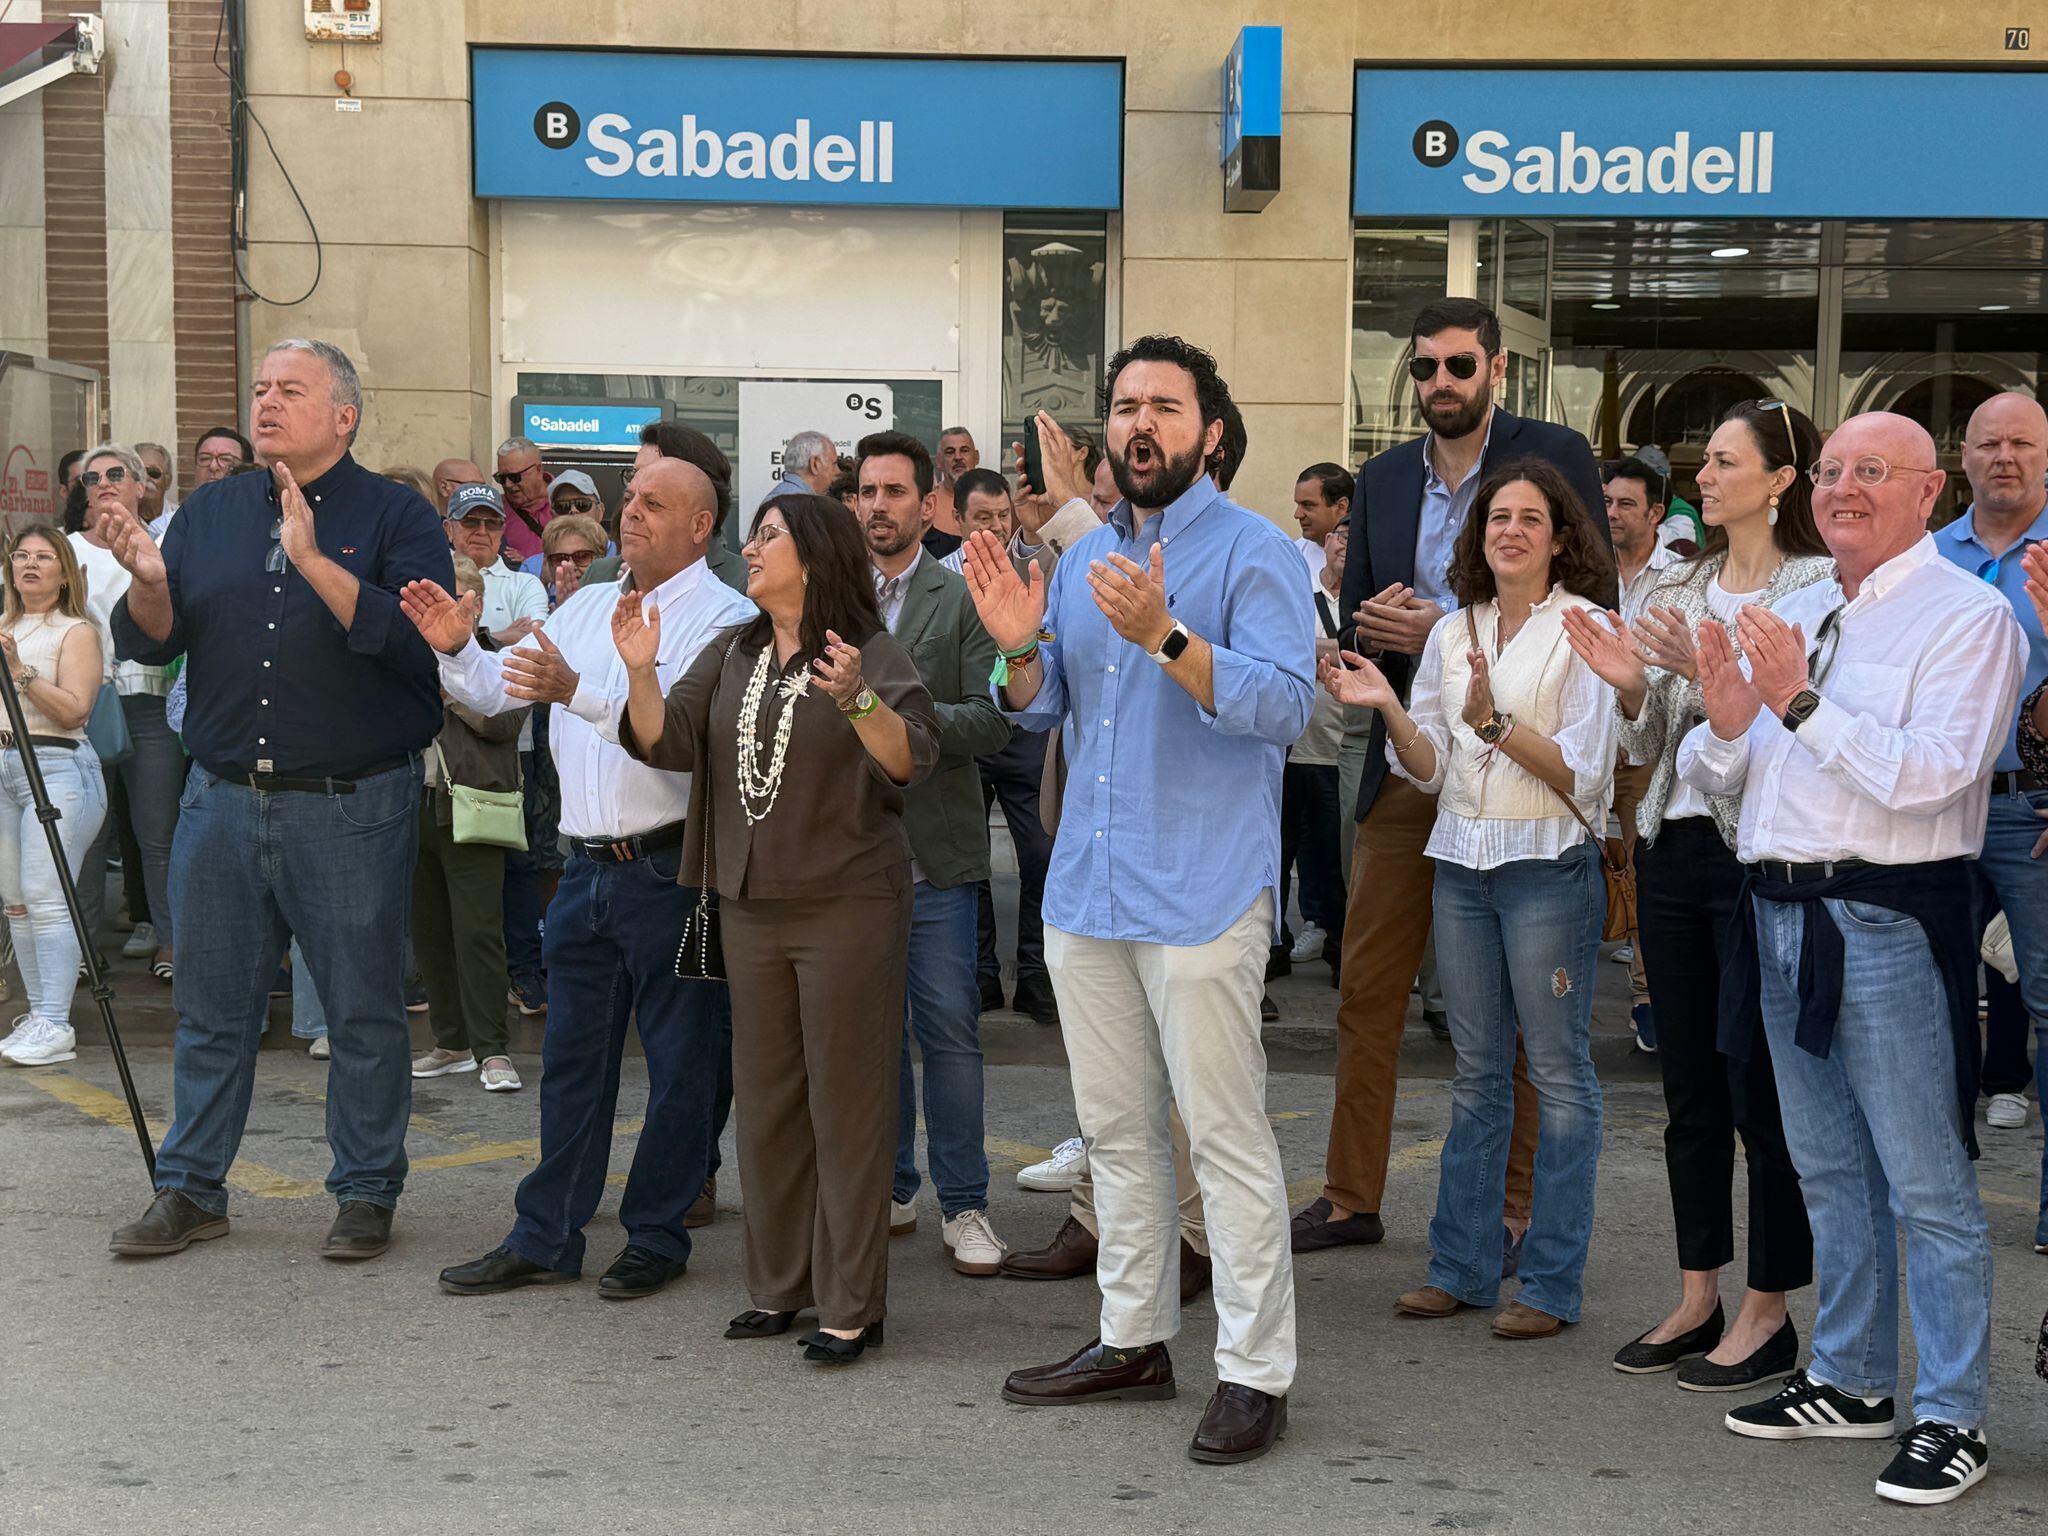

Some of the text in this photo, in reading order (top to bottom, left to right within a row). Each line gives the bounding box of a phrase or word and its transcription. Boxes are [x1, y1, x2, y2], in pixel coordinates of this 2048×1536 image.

[2007, 29, 2028, 49] 70
[584, 112, 894, 183] Sabadell
[1461, 129, 1774, 194] Sabadell
[864, 397, 882, 420] S
[540, 417, 600, 433] Sabadell
[460, 486, 495, 499] ROMA
